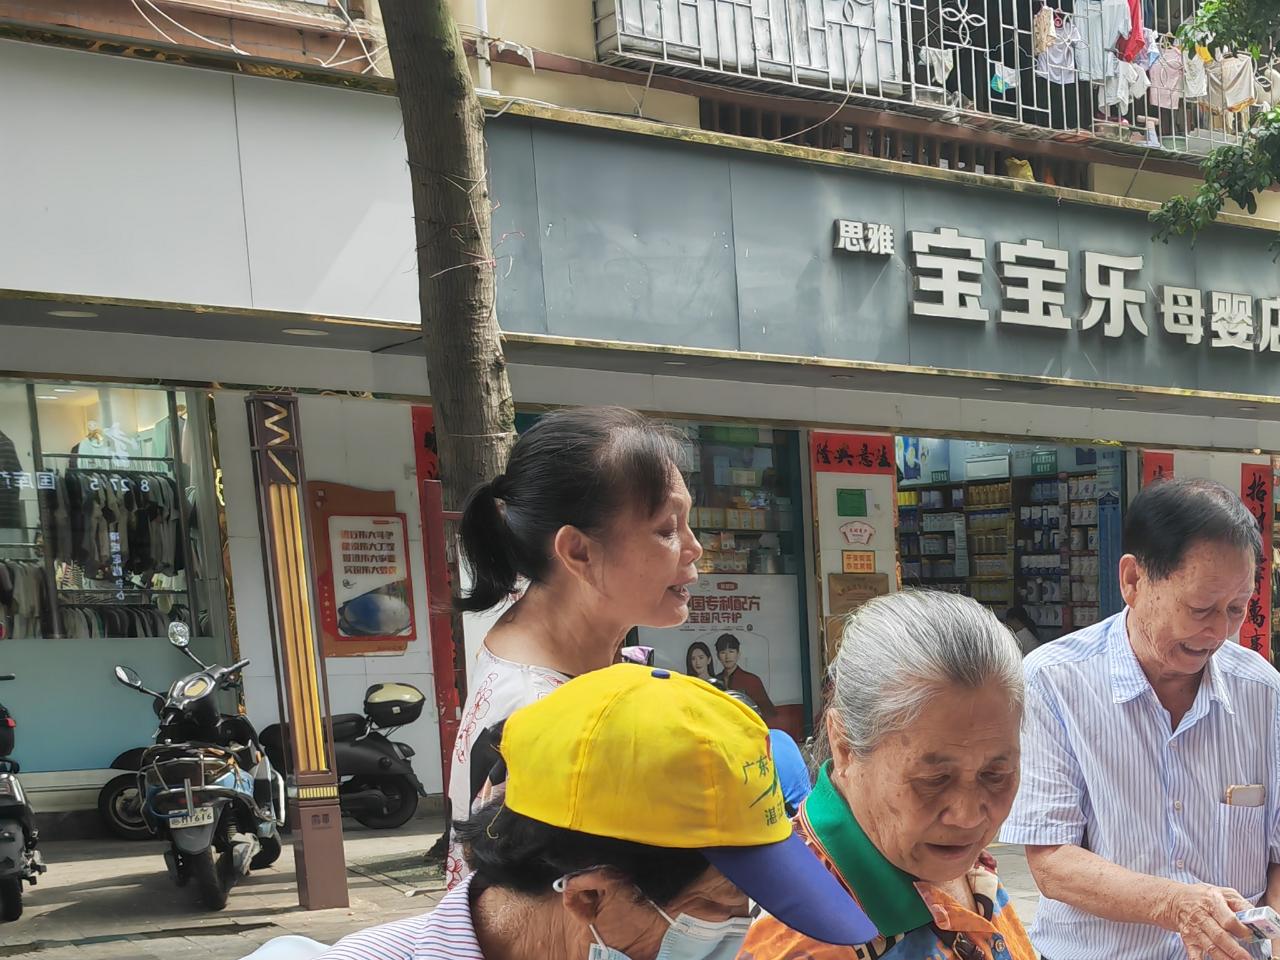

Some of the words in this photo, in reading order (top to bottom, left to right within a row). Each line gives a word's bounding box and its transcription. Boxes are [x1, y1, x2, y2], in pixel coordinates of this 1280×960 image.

[834, 218, 895, 256] 思雅
[909, 226, 1149, 338] 宝宝乐
[685, 611, 743, 624] 宝超凡守护
[687, 595, 761, 612] 国专利配方
[743, 755, 771, 785] 广东
